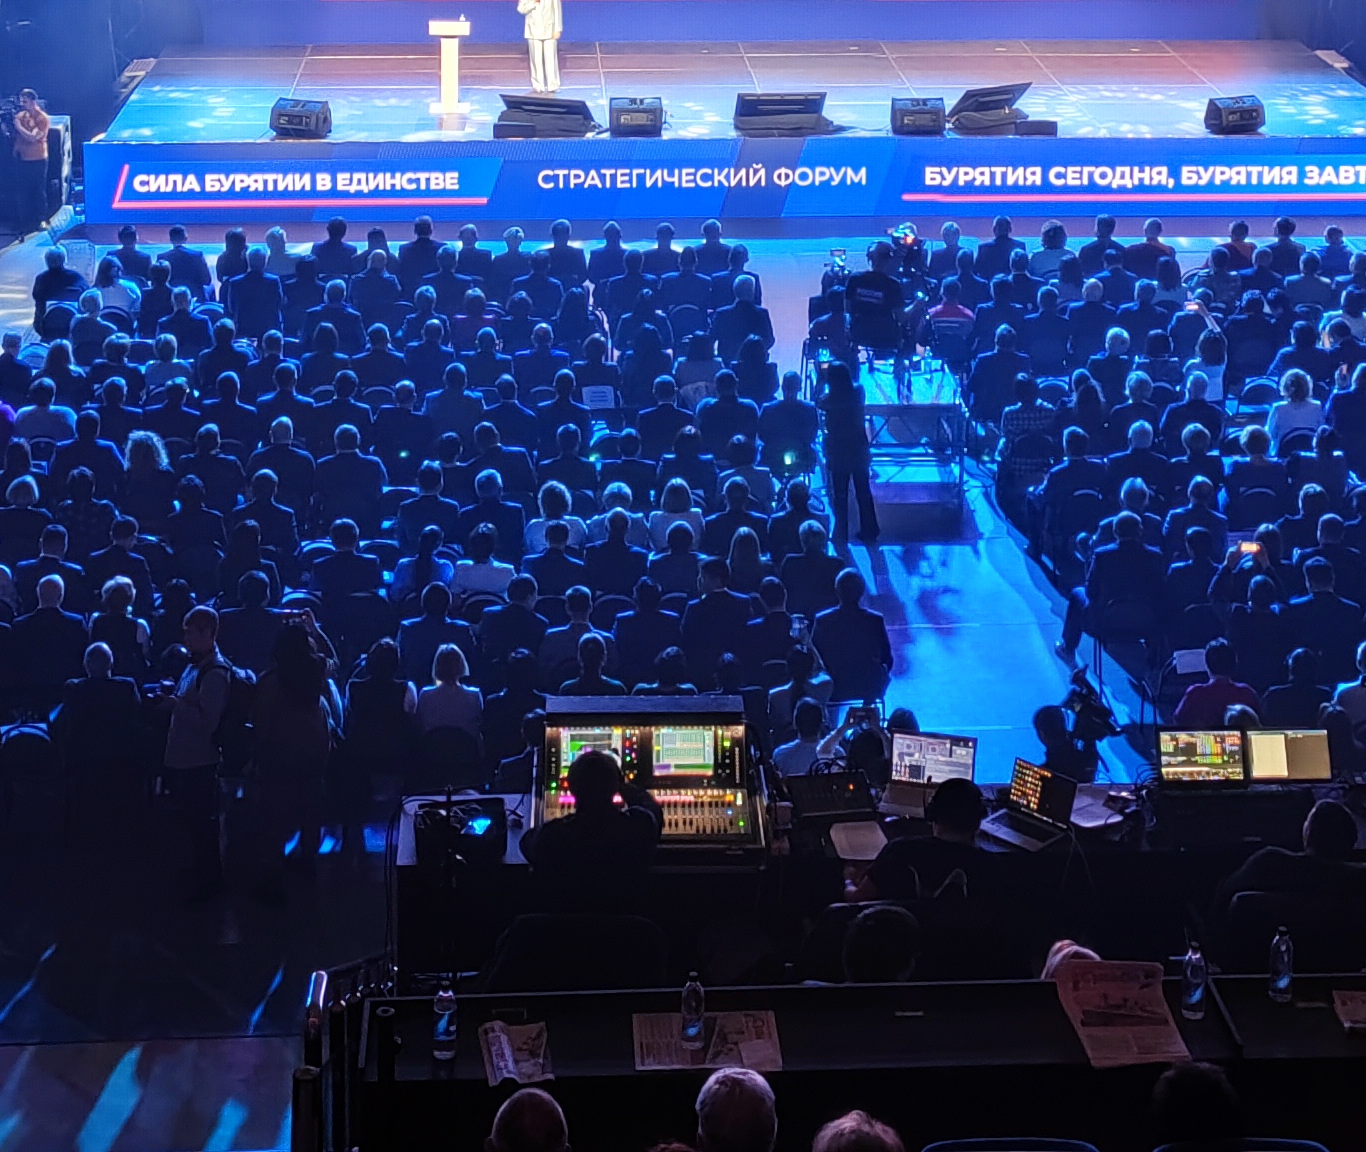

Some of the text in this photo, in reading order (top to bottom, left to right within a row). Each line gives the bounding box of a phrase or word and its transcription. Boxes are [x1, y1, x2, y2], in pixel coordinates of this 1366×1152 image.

[133, 172, 458, 192] СИЛА БУРЯТИИ В ЕДИНСТВЕ
[538, 163, 866, 188] СТРАТЕГИЧЕСКИЙ ФОРУМ
[925, 166, 1042, 186] БУРЯТИЯ
[1048, 166, 1173, 188] СЕГОДНЯ,
[1181, 164, 1296, 186] БУРЯТИЯ
